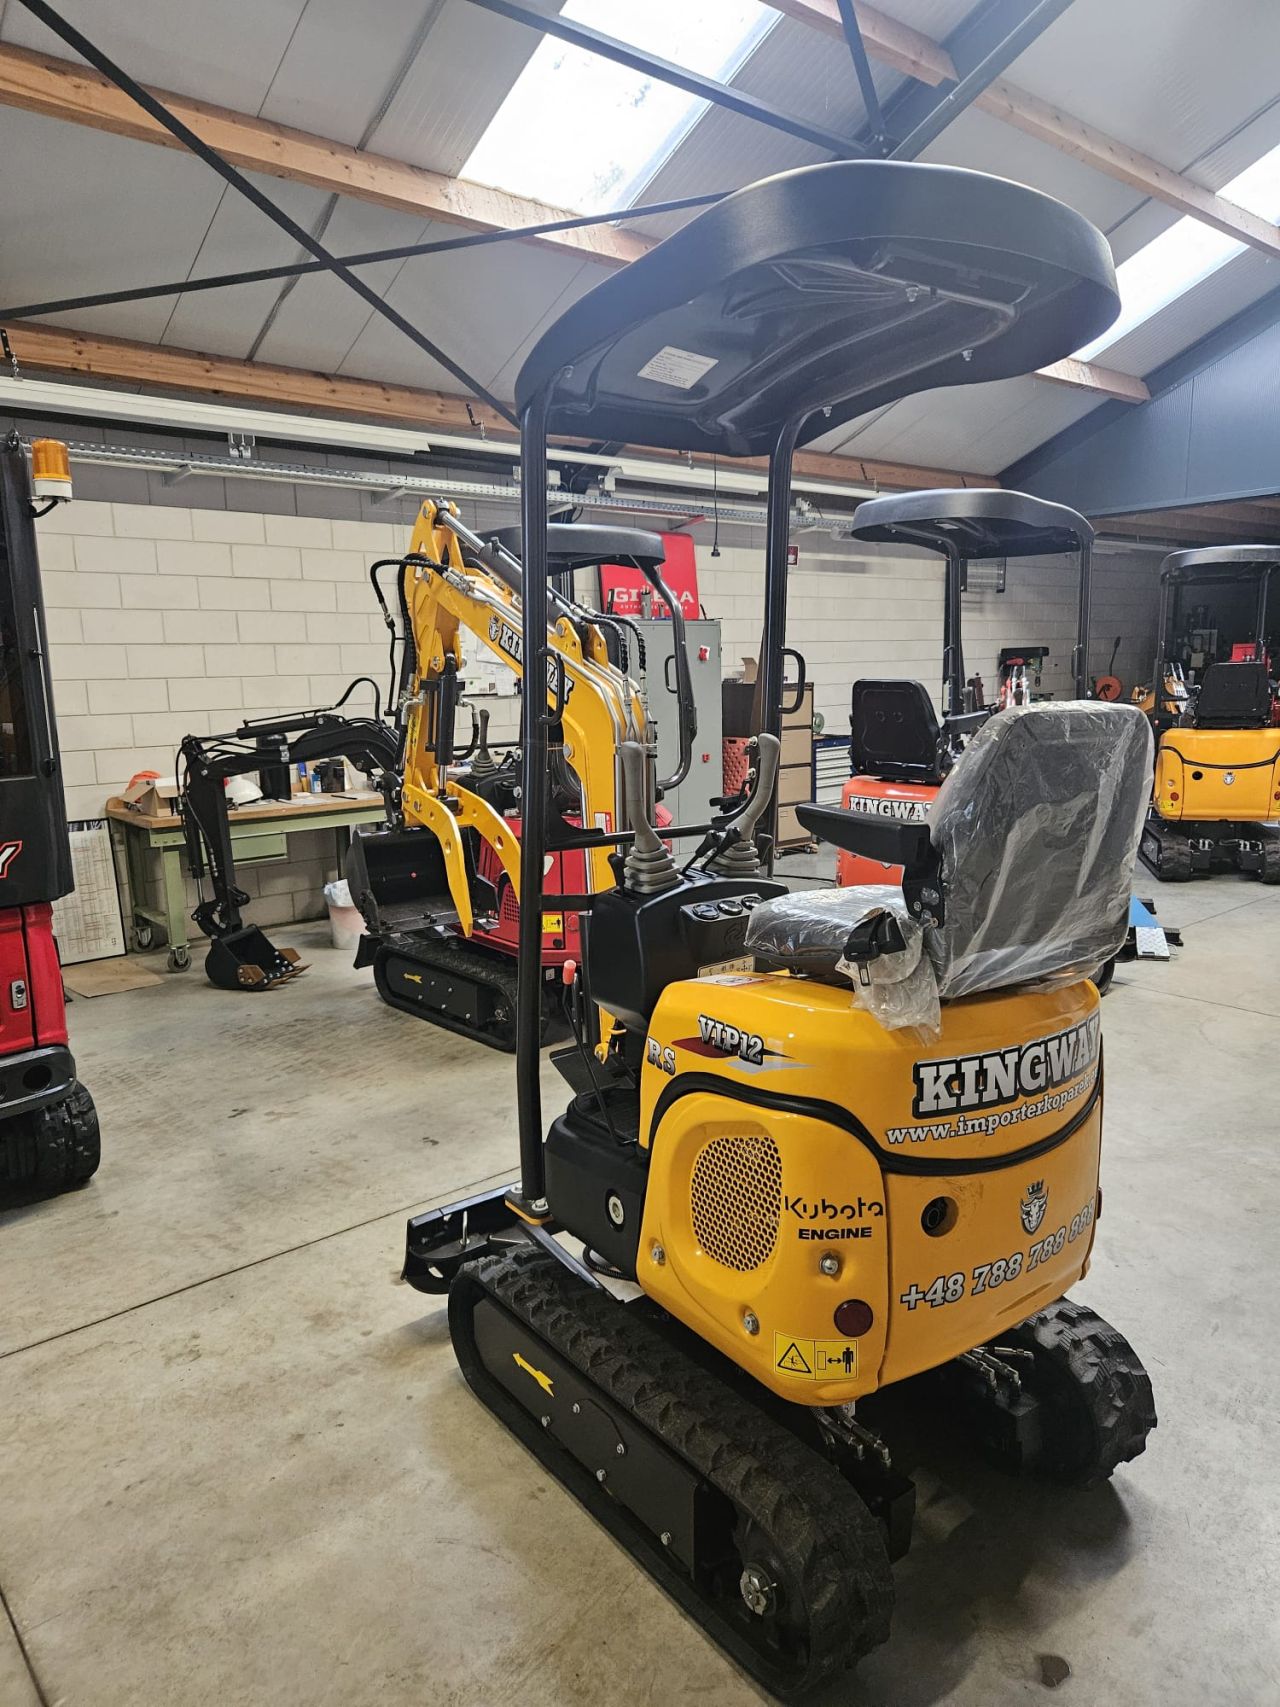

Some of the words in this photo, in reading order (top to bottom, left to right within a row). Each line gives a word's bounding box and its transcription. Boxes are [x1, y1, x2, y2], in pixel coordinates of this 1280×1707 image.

[647, 1036, 676, 1076] RS
[698, 1014, 764, 1066] VIP12
[913, 1008, 1100, 1119] KINGWAY
[784, 1195, 884, 1220] Kubota
[798, 1227, 872, 1240] ENGINE
[900, 1272, 966, 1311] +48
[971, 1252, 1024, 1297] 788
[1026, 1225, 1067, 1274] 788
